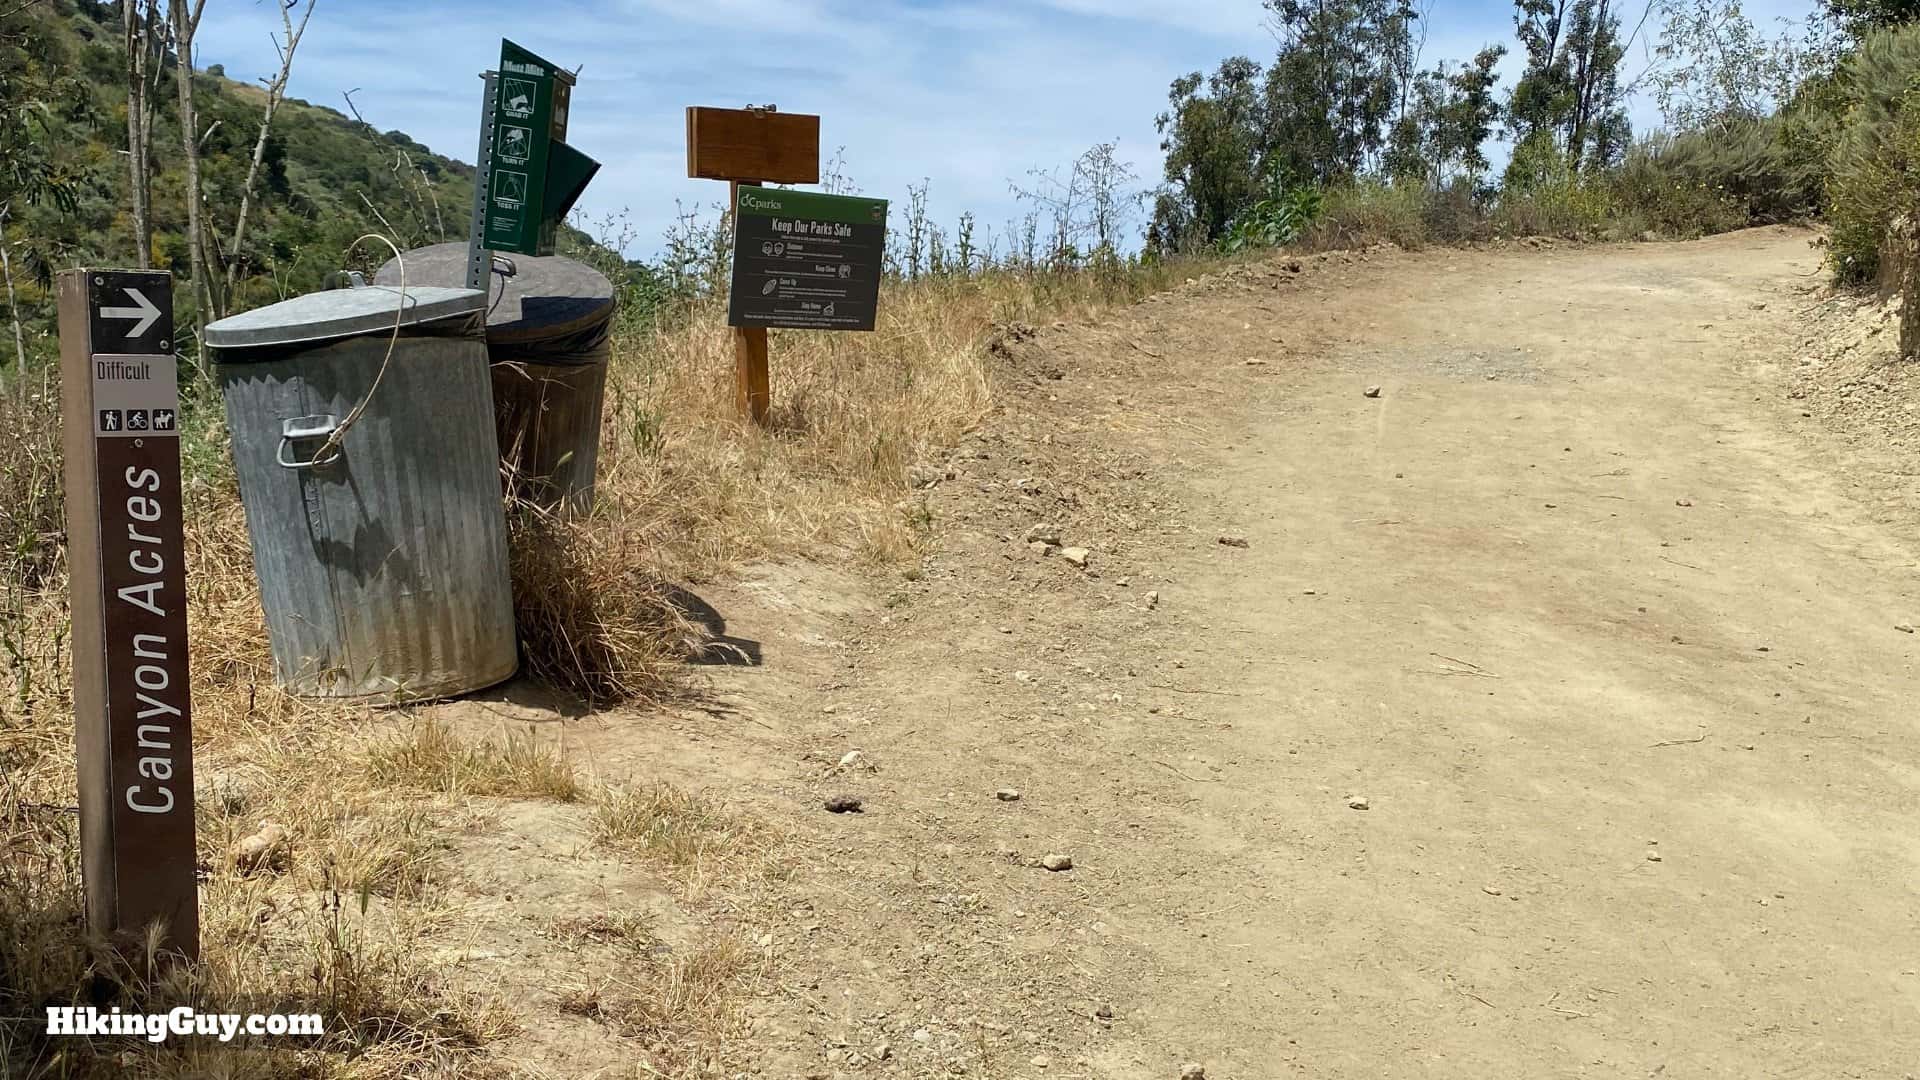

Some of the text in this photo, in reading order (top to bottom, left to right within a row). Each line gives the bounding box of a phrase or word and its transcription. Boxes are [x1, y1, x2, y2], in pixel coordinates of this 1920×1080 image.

[772, 217, 852, 237] Keep Our Parks Safe
[97, 361, 151, 380] Difficult
[118, 466, 181, 814] Canyon Acres
